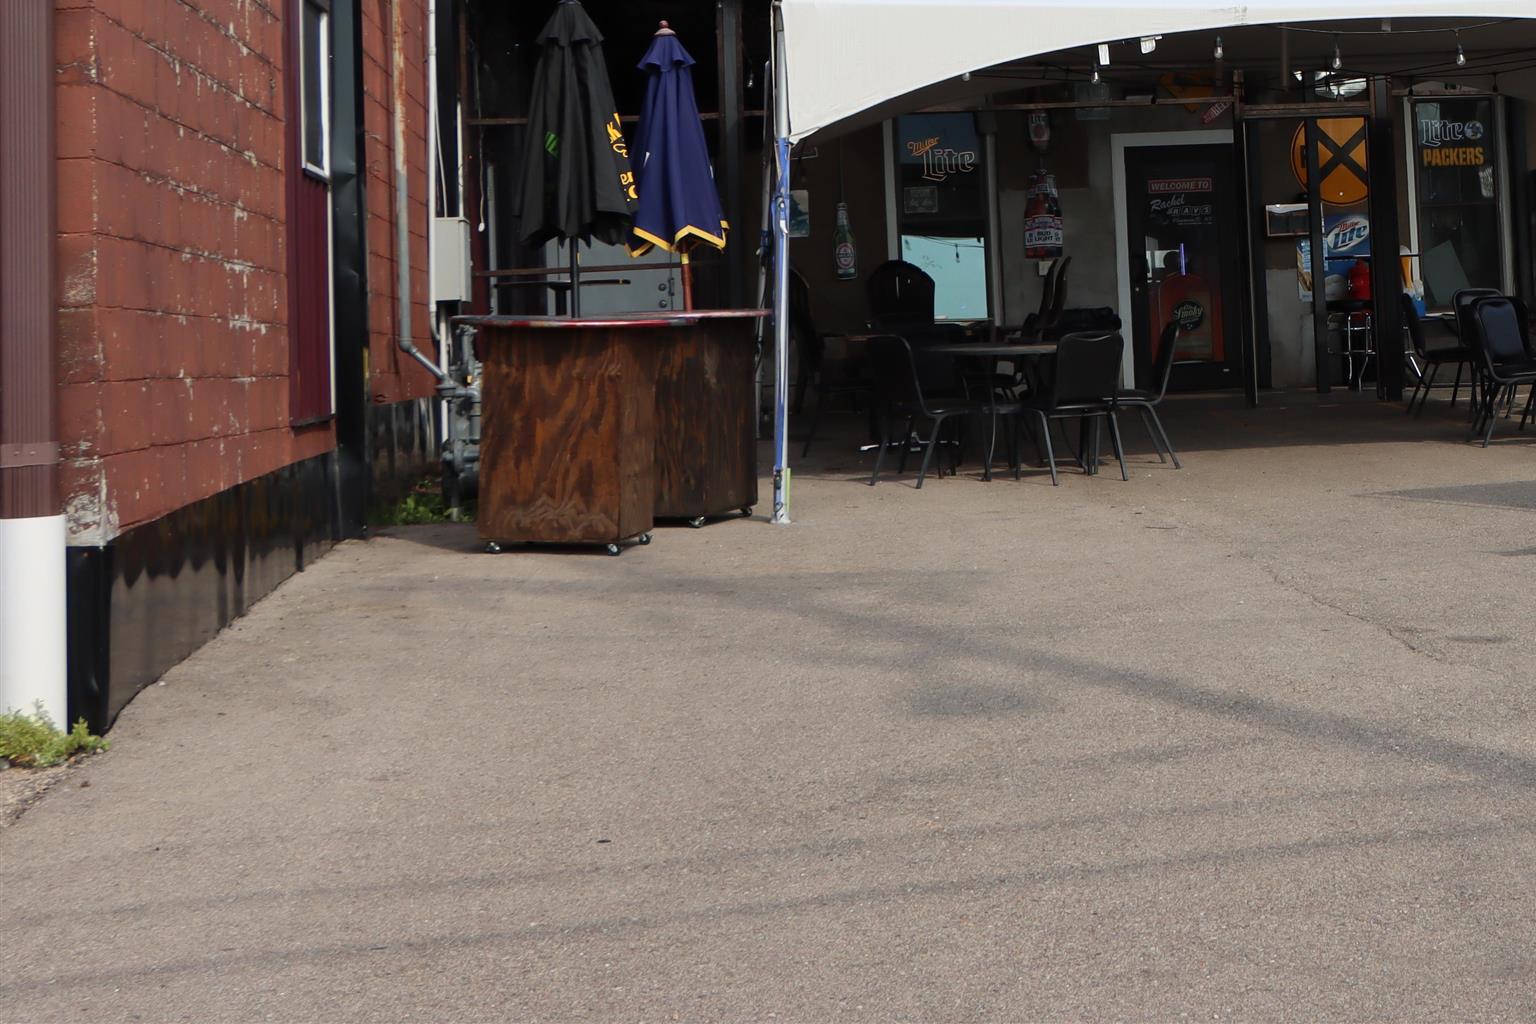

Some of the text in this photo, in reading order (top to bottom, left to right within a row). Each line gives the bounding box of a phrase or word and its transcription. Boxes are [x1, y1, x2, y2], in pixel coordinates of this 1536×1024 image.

[1421, 119, 1464, 147] Lite
[907, 136, 941, 156] Miller
[920, 148, 976, 182] Lite
[1423, 146, 1485, 168] PACKERS
[1151, 180, 1209, 191] WELCOME TO
[1150, 193, 1185, 212] Rachel
